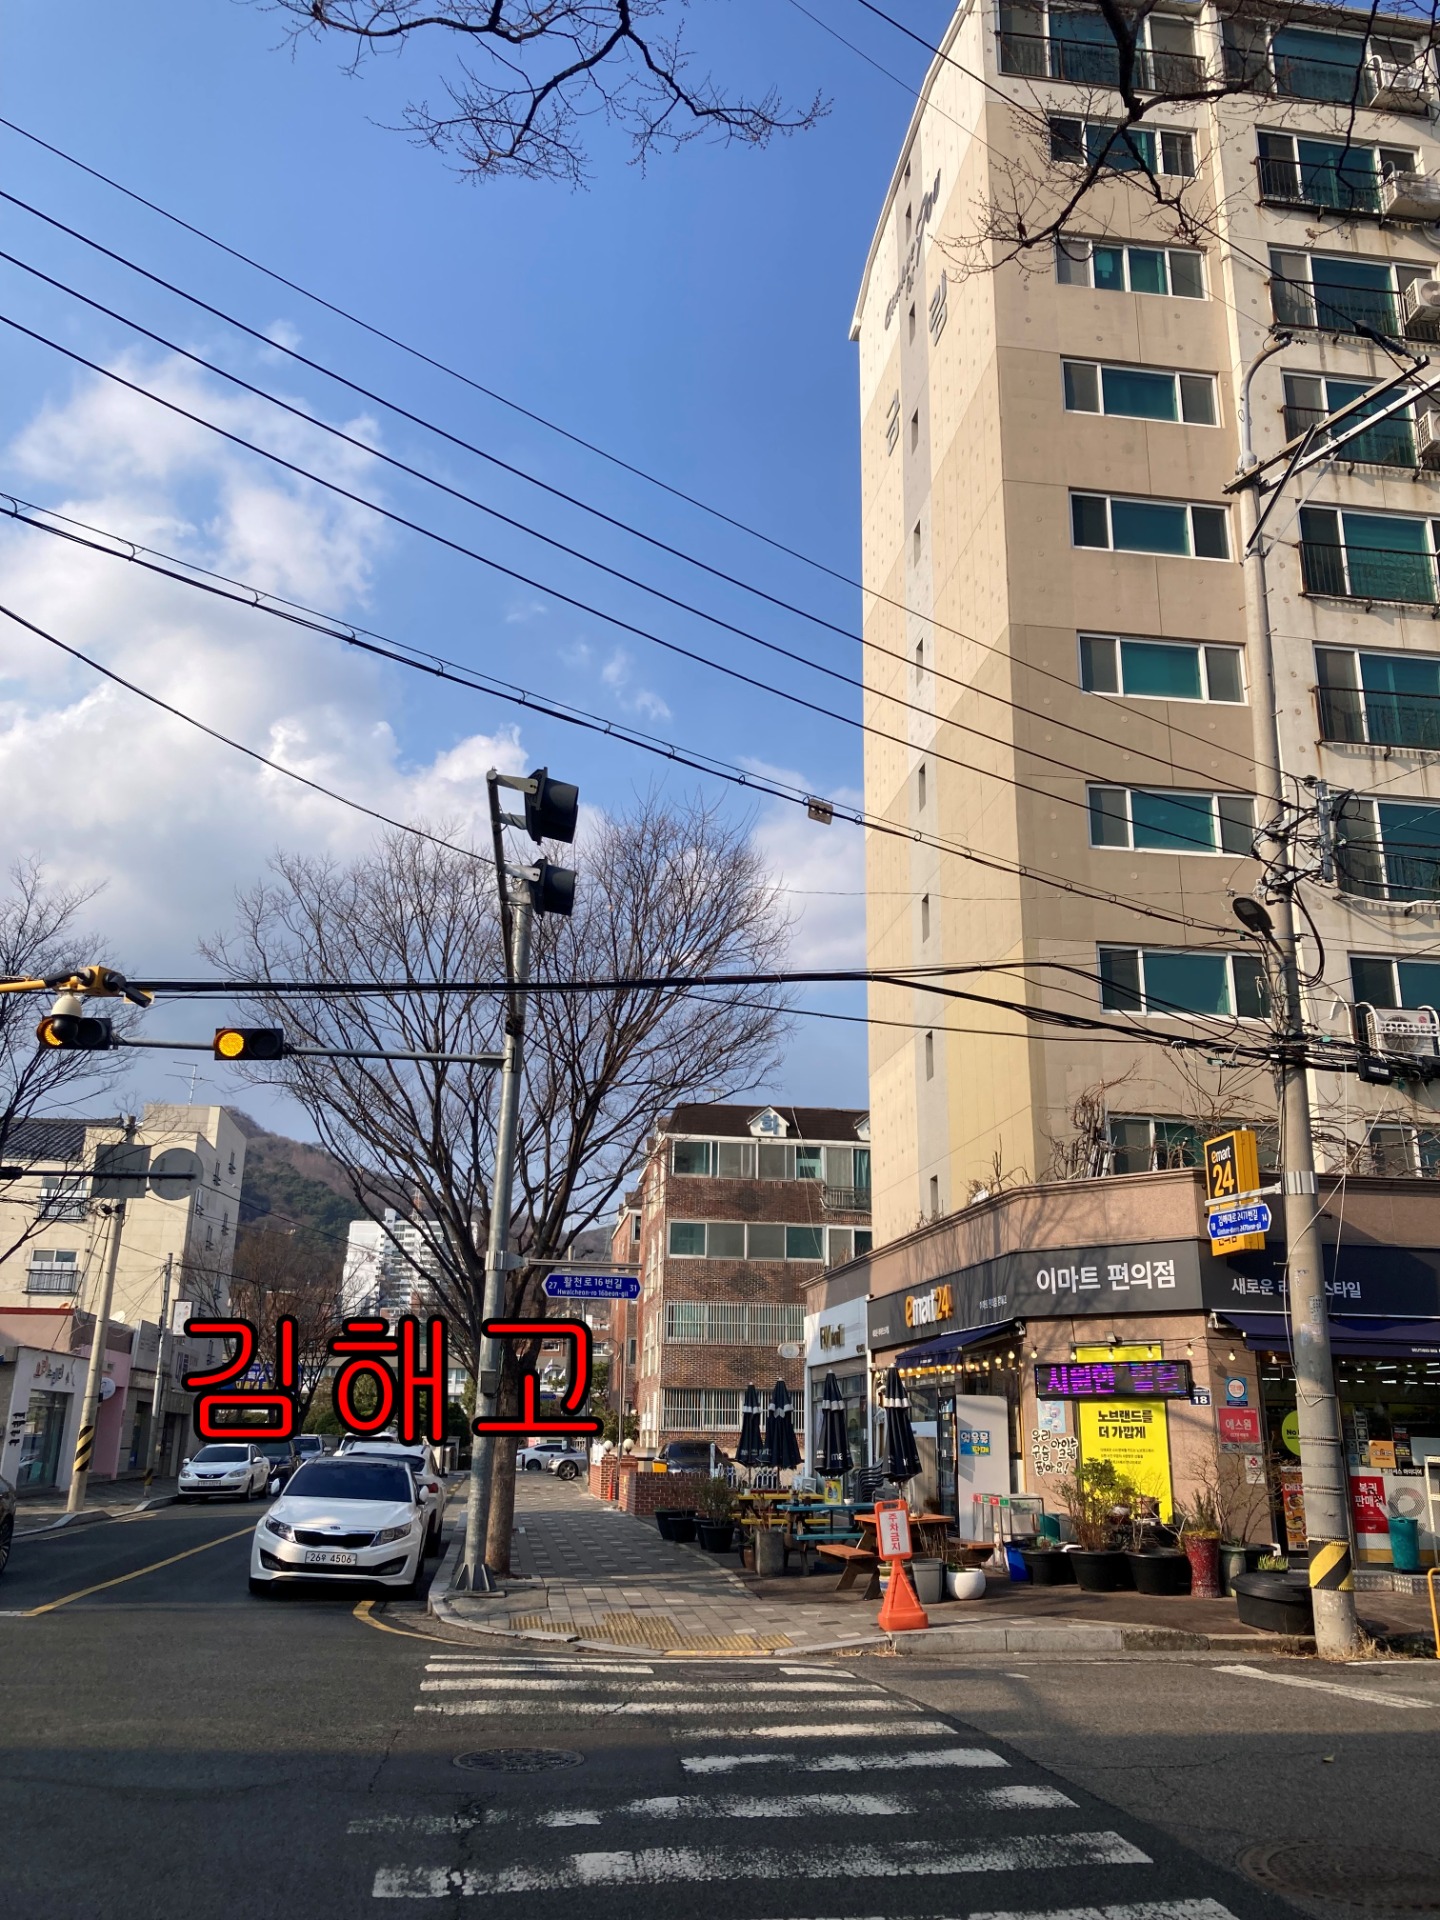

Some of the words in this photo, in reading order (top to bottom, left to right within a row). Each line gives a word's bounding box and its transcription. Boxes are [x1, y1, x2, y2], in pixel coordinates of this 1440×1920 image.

[1211, 1146, 1231, 1163] emart
[1212, 1160, 1235, 1197] 24
[1035, 1264, 1101, 1295] 이마트
[1106, 1257, 1177, 1291] 편의점
[548, 1281, 558, 1290] 27
[629, 1284, 637, 1292] 31
[1230, 1277, 1274, 1296] 새로운
[1193, 1395, 1208, 1405] 18
[1097, 1409, 1154, 1424] 노브랜드를
[1225, 1418, 1252, 1431] 에스원
[1286, 1428, 1297, 1436] No
[1031, 1429, 1051, 1442] 우리
[1098, 1425, 1109, 1439] 더
[1111, 1425, 1146, 1440] 가깝게
[1050, 1437, 1078, 1449] 아이스
[1058, 1448, 1076, 1460] 크림
[1035, 1460, 1070, 1476] 팔아요!
[1357, 1481, 1378, 1497] 복권
[888, 1512, 901, 1551] 주차금지
[330, 1554, 352, 1564] 4506
